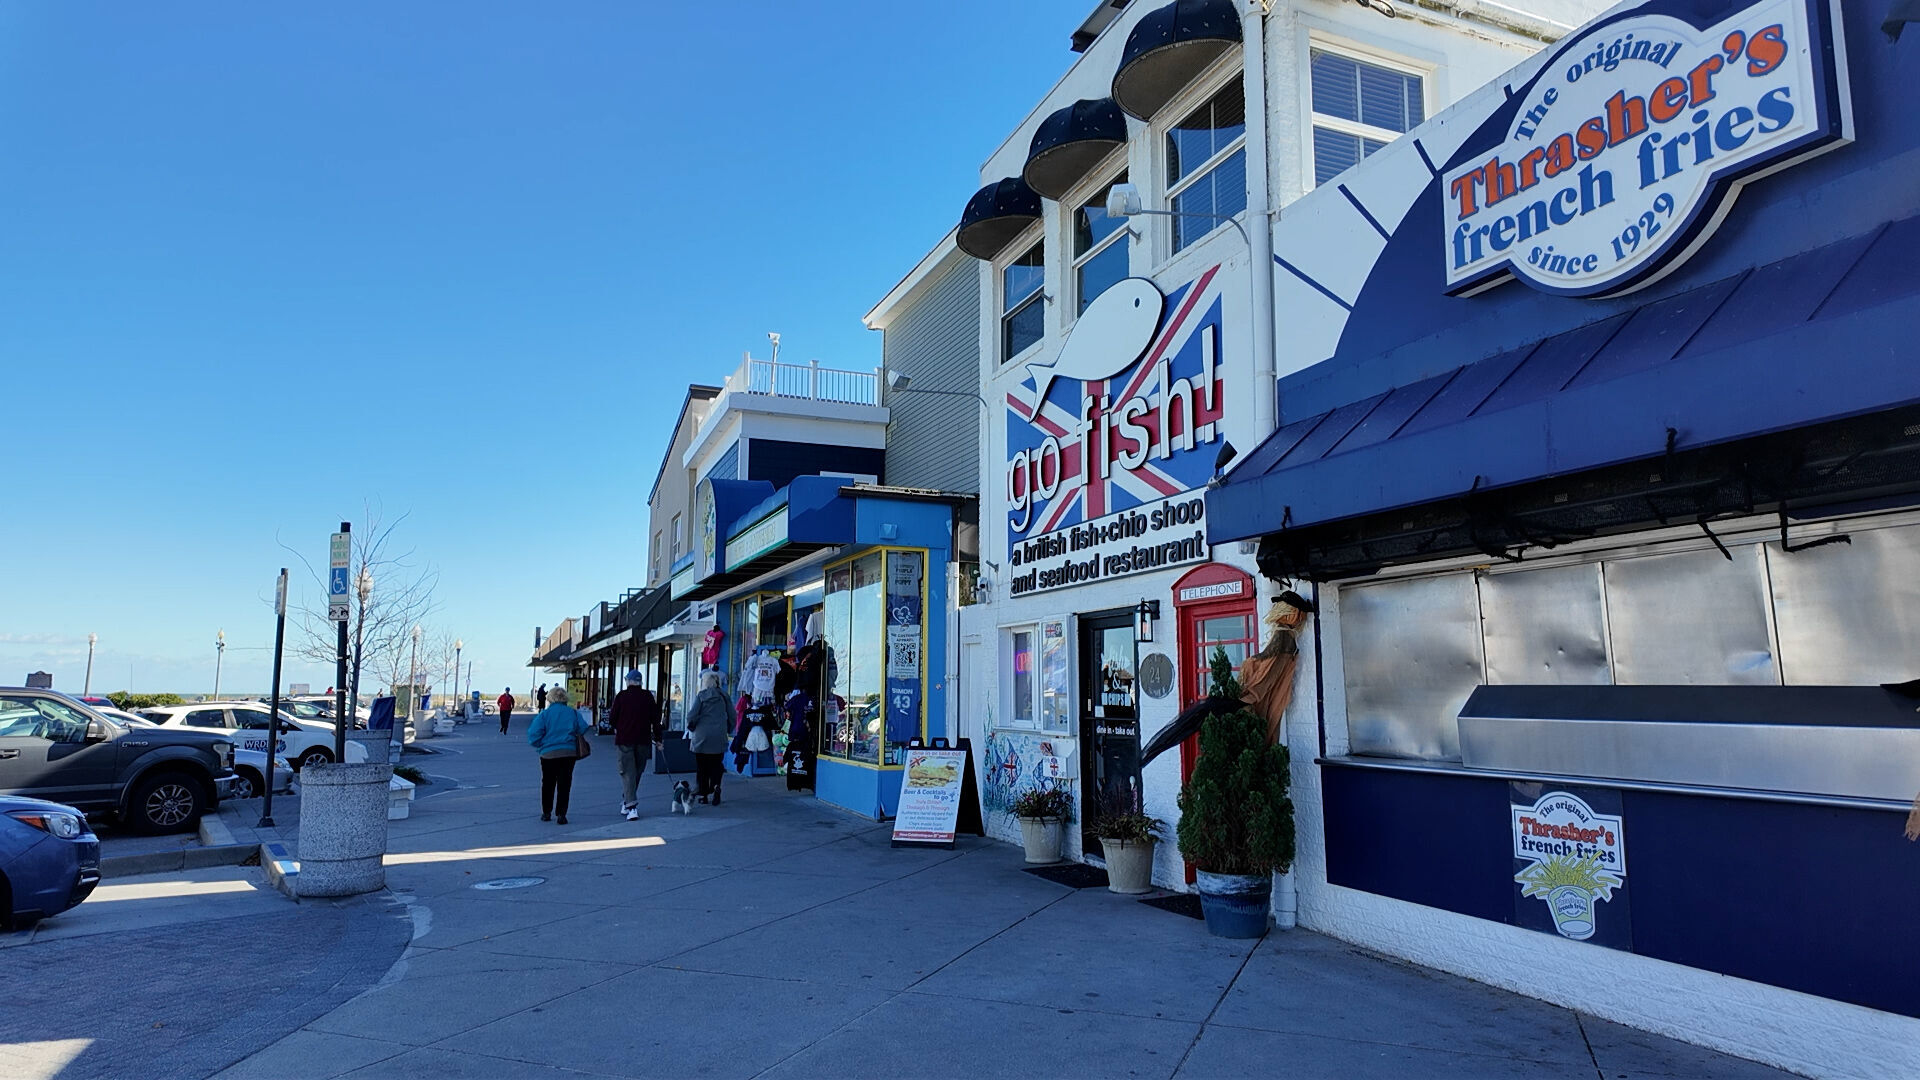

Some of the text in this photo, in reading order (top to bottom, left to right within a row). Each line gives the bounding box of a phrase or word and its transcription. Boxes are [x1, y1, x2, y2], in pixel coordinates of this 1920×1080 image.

[1514, 34, 1683, 142] The original
[1450, 23, 1788, 221] Thrasher's
[1452, 86, 1795, 271] french fries
[1527, 192, 1676, 276] since 1929
[1008, 324, 1216, 534] go fish!
[1012, 498, 1204, 567] a british fish+chip shop
[1011, 531, 1205, 594] and seafood restaurant
[1181, 582, 1241, 600] TELEPHONE
[1149, 666, 1160, 683] 24
[893, 694, 911, 709] 43
[1096, 725, 1107, 734] dine
[1115, 726, 1126, 736] take
[1126, 727, 1136, 736] out
[1519, 816, 1615, 847] Thrasher's
[1540, 801, 1590, 823] The original
[1521, 836, 1616, 863] french fries
